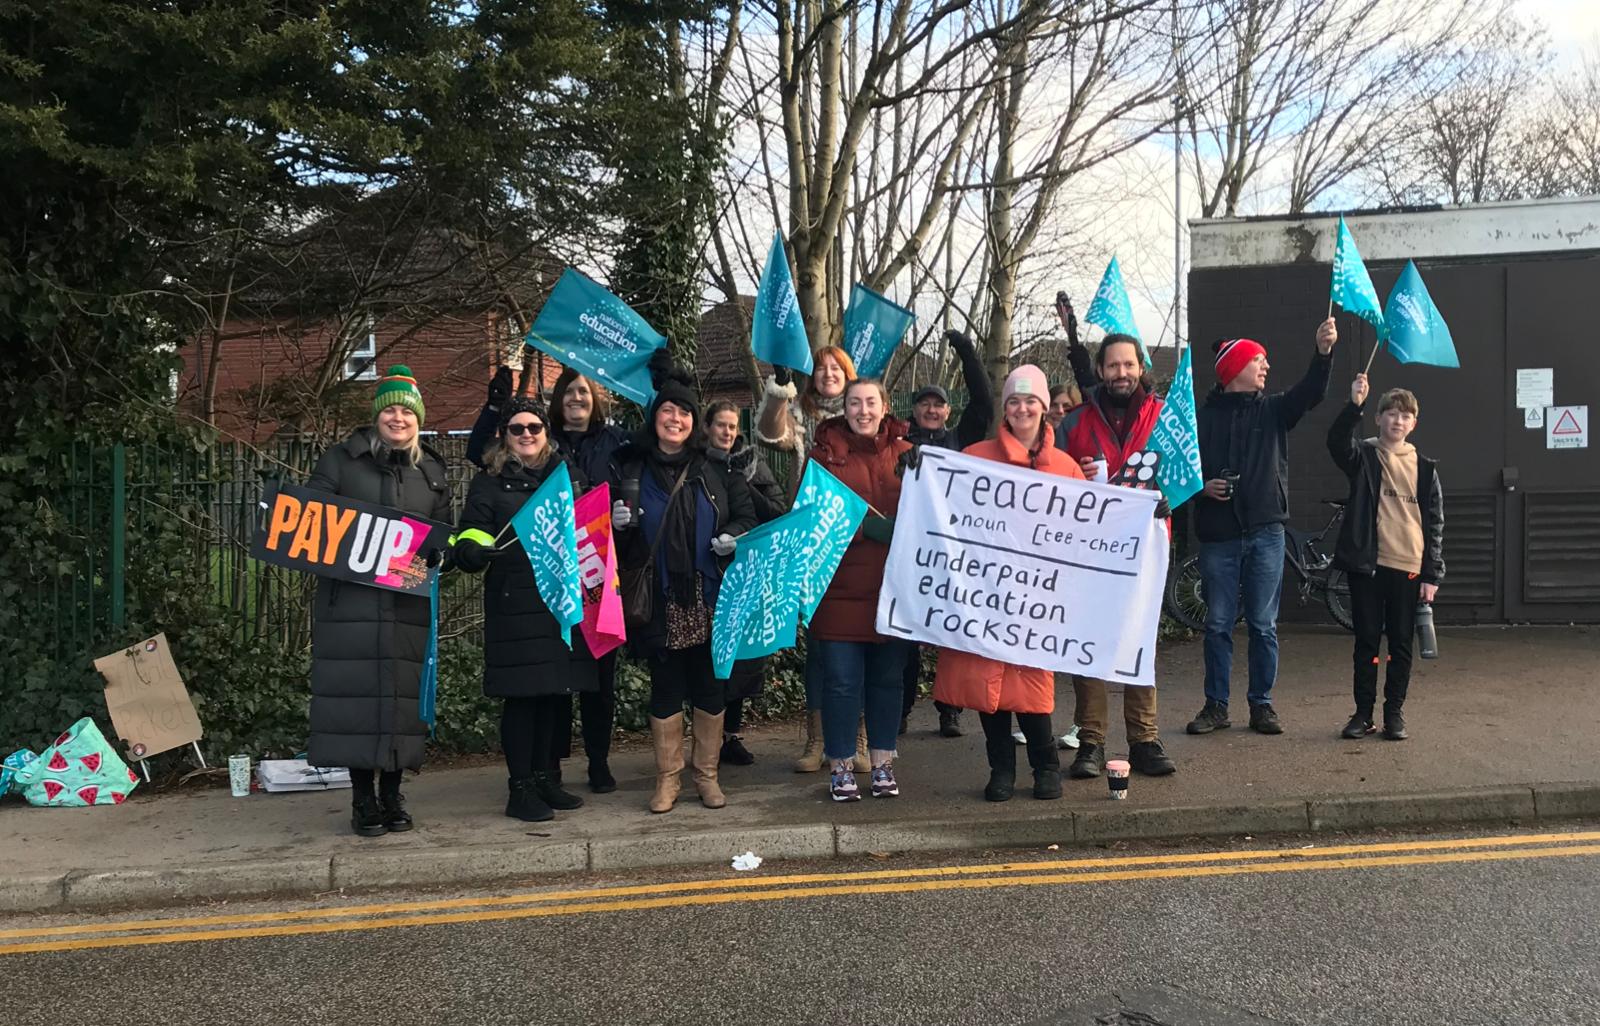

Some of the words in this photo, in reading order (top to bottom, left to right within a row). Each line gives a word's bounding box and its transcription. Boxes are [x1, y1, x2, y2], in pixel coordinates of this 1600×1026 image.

[578, 312, 638, 353] education
[593, 332, 614, 351] union
[599, 313, 630, 335] national
[1173, 389, 1197, 427] nation
[937, 467, 1123, 525] Teacher
[265, 492, 357, 565] PAY
[348, 512, 415, 577] UP
[962, 513, 1007, 532] noun
[916, 547, 1059, 592] underpaid
[919, 574, 1066, 624] education
